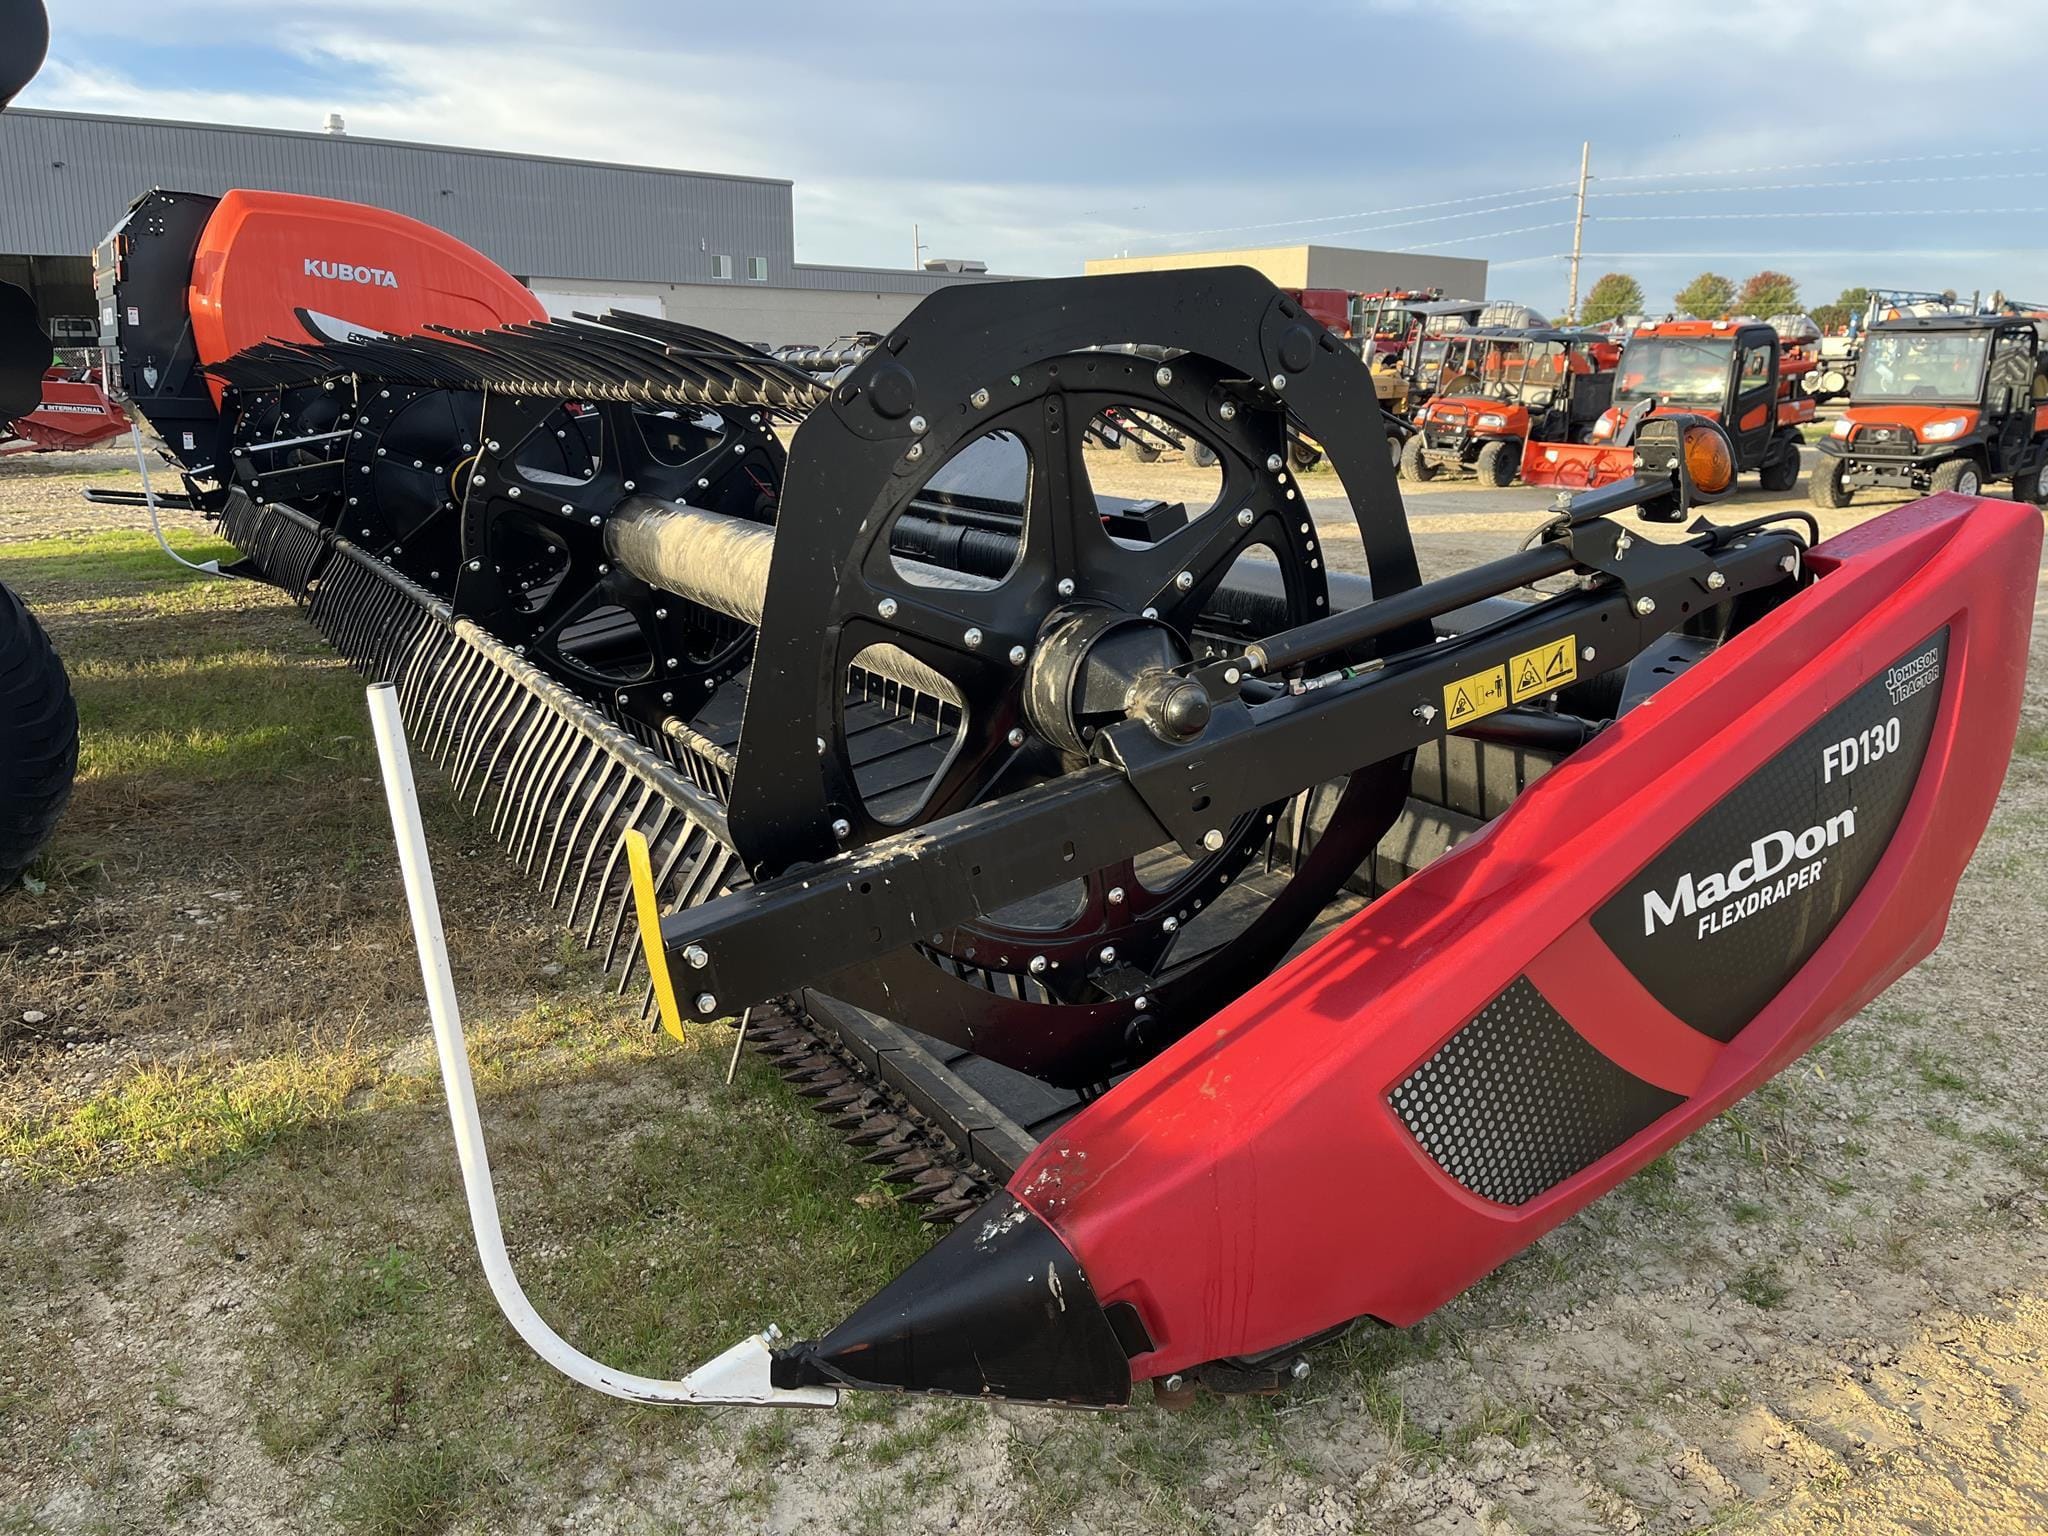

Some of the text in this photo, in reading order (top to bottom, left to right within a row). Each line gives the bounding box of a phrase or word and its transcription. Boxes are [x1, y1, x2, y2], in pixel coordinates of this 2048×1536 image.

[304, 258, 398, 288] KUBOTA
[47, 405, 101, 413] INTERNATIONAL
[1885, 647, 1938, 689] JOHNSON
[1889, 664, 1940, 706] TRACTOR
[1823, 717, 1901, 784] FD130
[1643, 809, 1856, 937] MacDon
[1697, 861, 1824, 941] FLEXDRAPER
